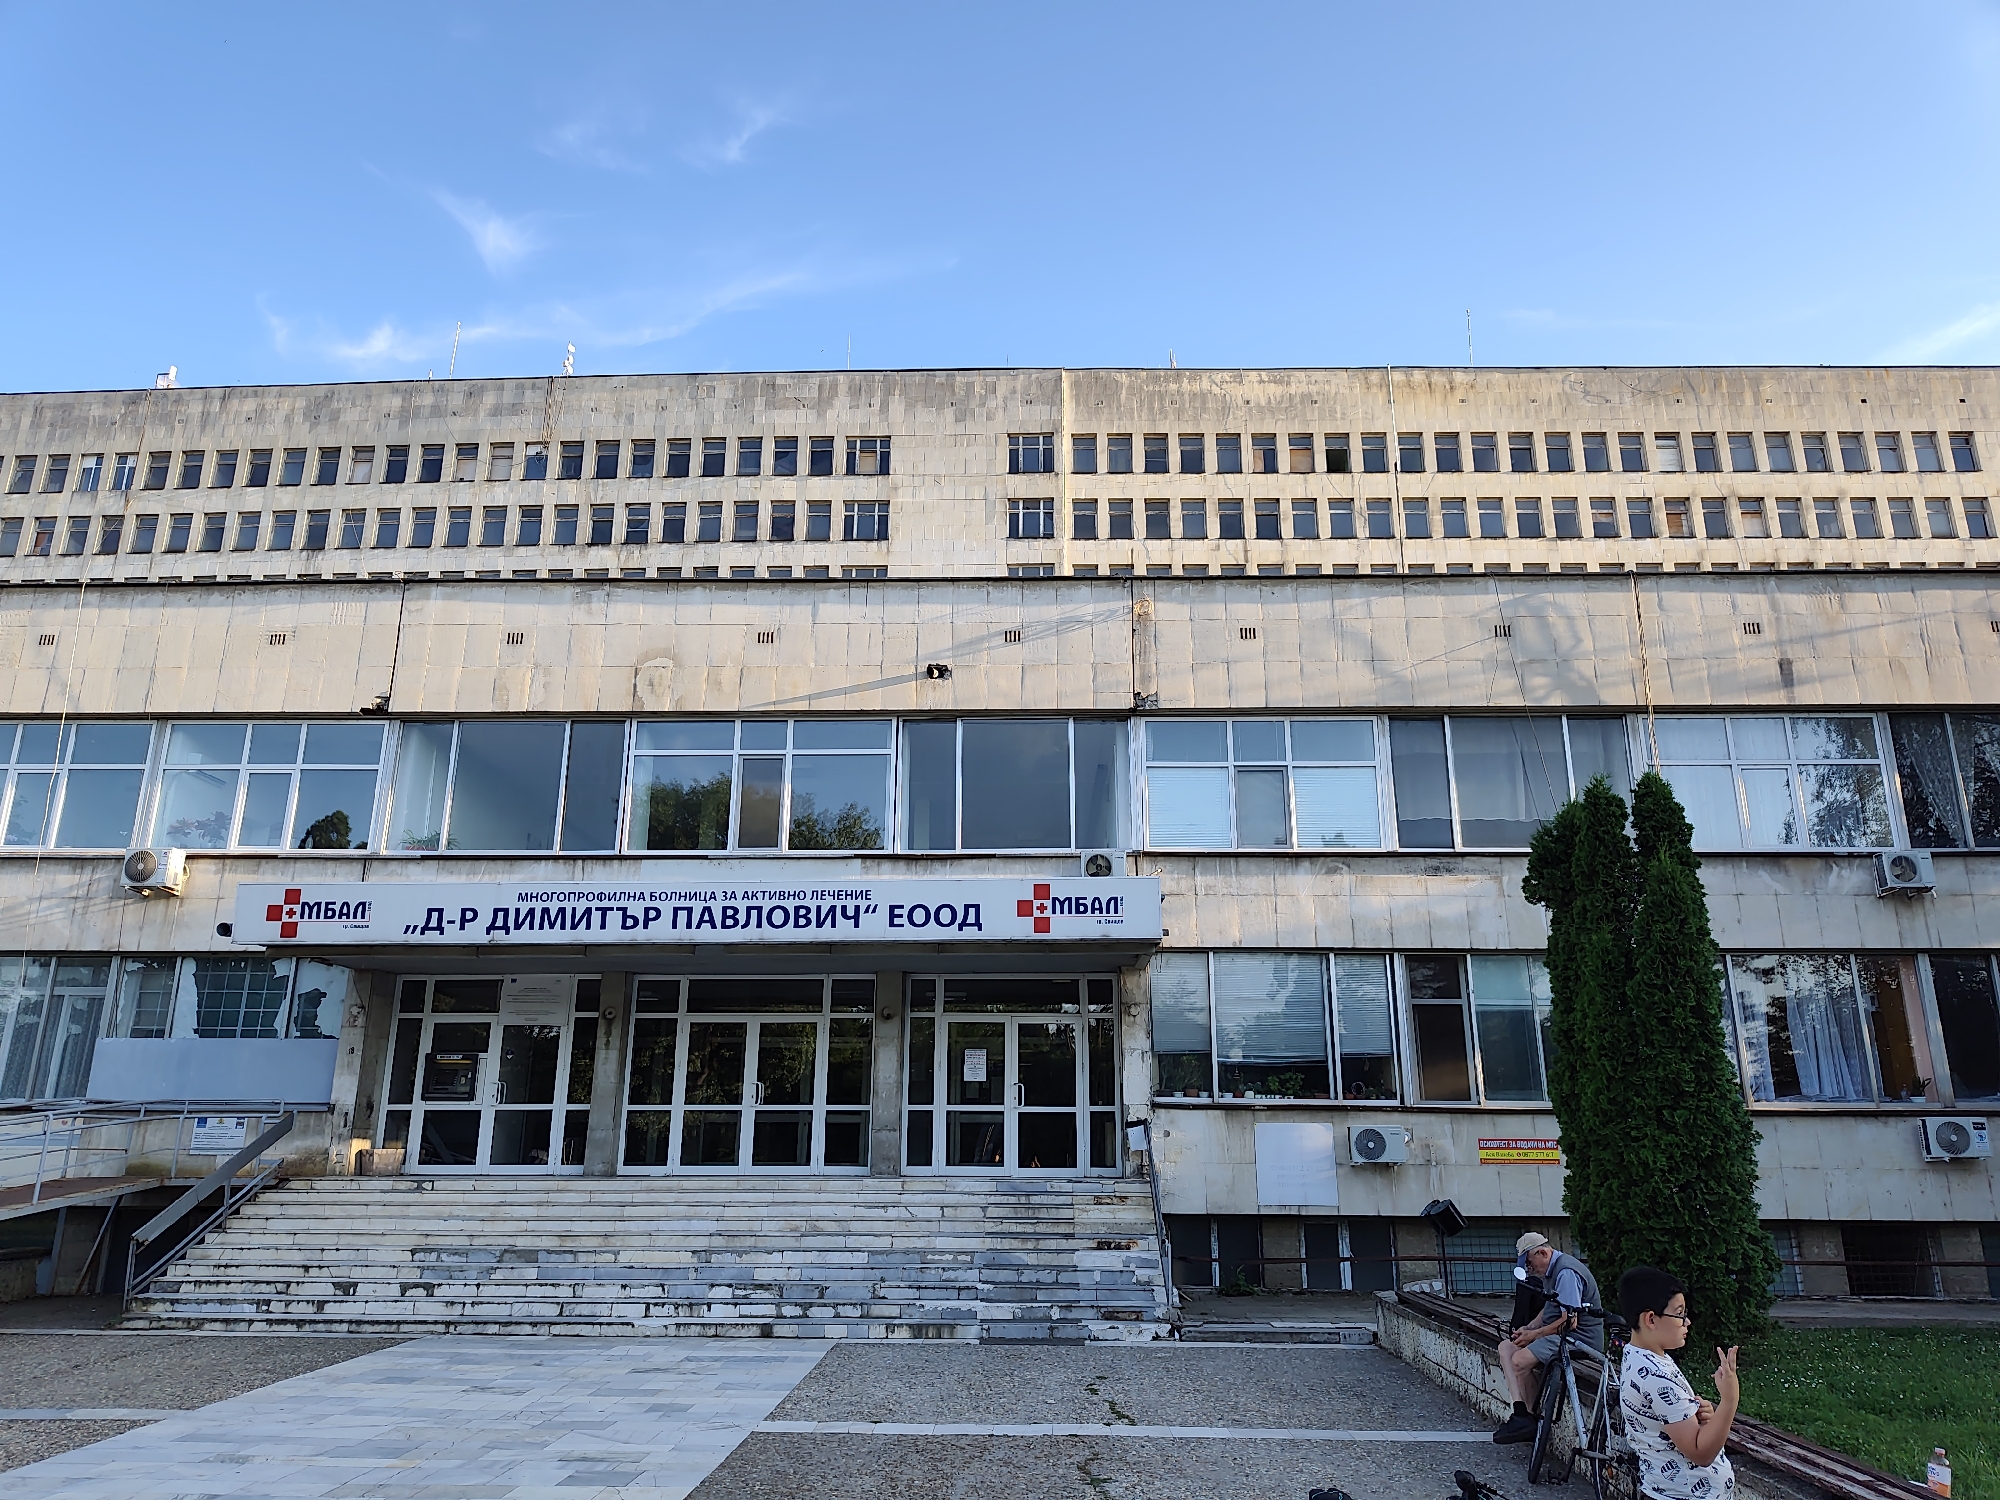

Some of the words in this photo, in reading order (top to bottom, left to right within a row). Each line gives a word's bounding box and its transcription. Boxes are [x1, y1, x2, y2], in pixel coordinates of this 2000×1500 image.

[517, 891, 647, 903] МНОГОПРОФИЛНА
[649, 891, 718, 903] БОЛНИЦА
[720, 890, 737, 902] ЗА
[741, 890, 807, 902] АКТИВНО
[809, 889, 873, 901] ЛЕЧЕНИЕ
[1051, 896, 1119, 915] МБАЛ
[300, 901, 367, 920] МБАЛ
[485, 906, 662, 936] ДИМИТЪР
[888, 903, 983, 932] ЕООД
[1509, 1140, 1516, 1148] ЗА
